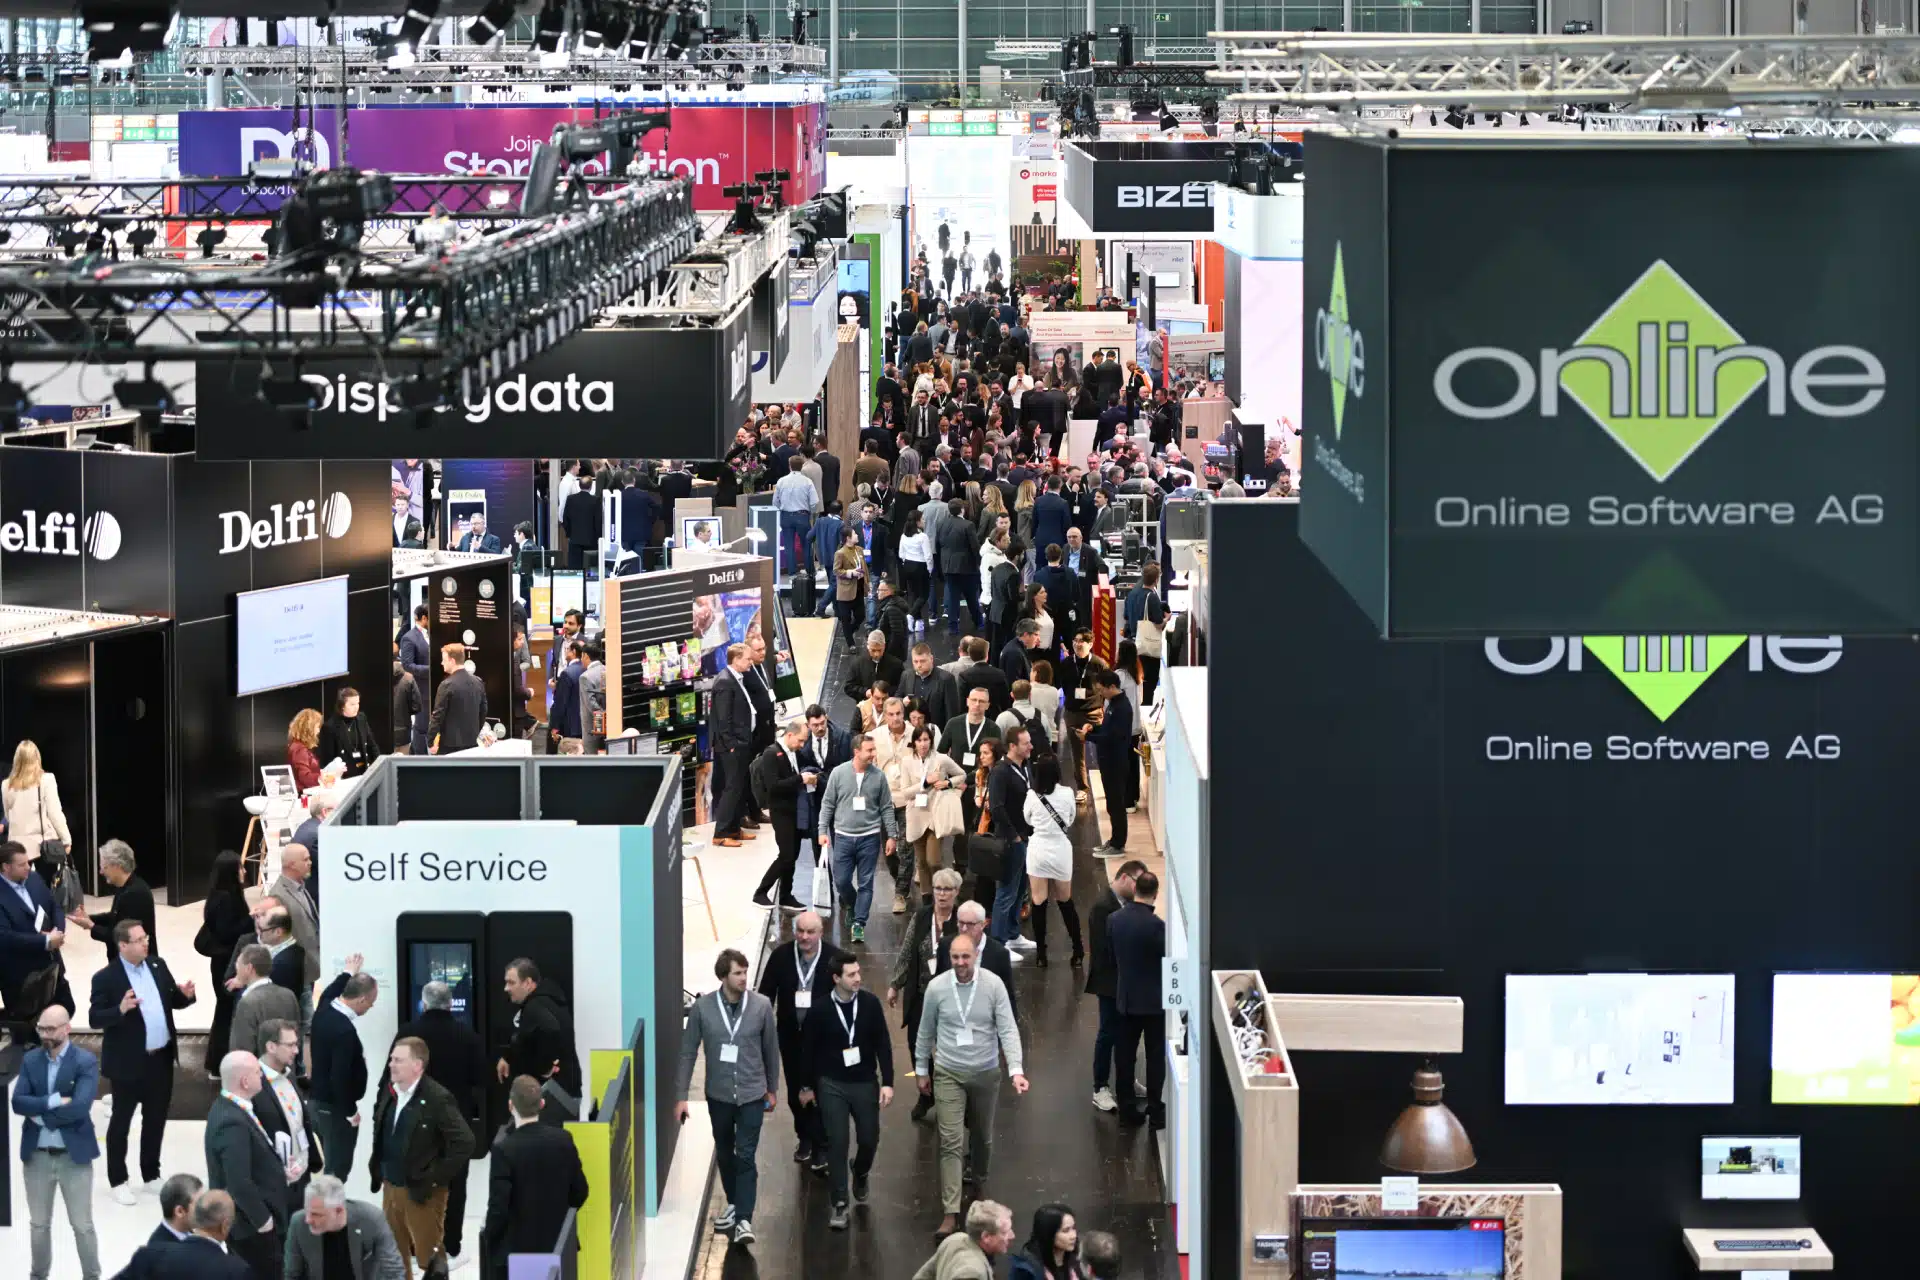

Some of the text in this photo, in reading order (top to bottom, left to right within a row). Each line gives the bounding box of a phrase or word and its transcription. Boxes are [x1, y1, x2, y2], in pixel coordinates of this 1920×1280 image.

[1433, 321, 1887, 419] online
[301, 373, 615, 423] Dispydata
[1435, 495, 1885, 527] Online Software AG
[0, 509, 80, 556] elfi
[218, 498, 319, 556] Delfi
[708, 569, 735, 586] Delfi
[1485, 734, 1842, 761] Online Software AG
[343, 852, 549, 882] Self Service
[1171, 962, 1179, 974] 6
[1171, 978, 1179, 989] B
[1167, 994, 1182, 1005] 60
